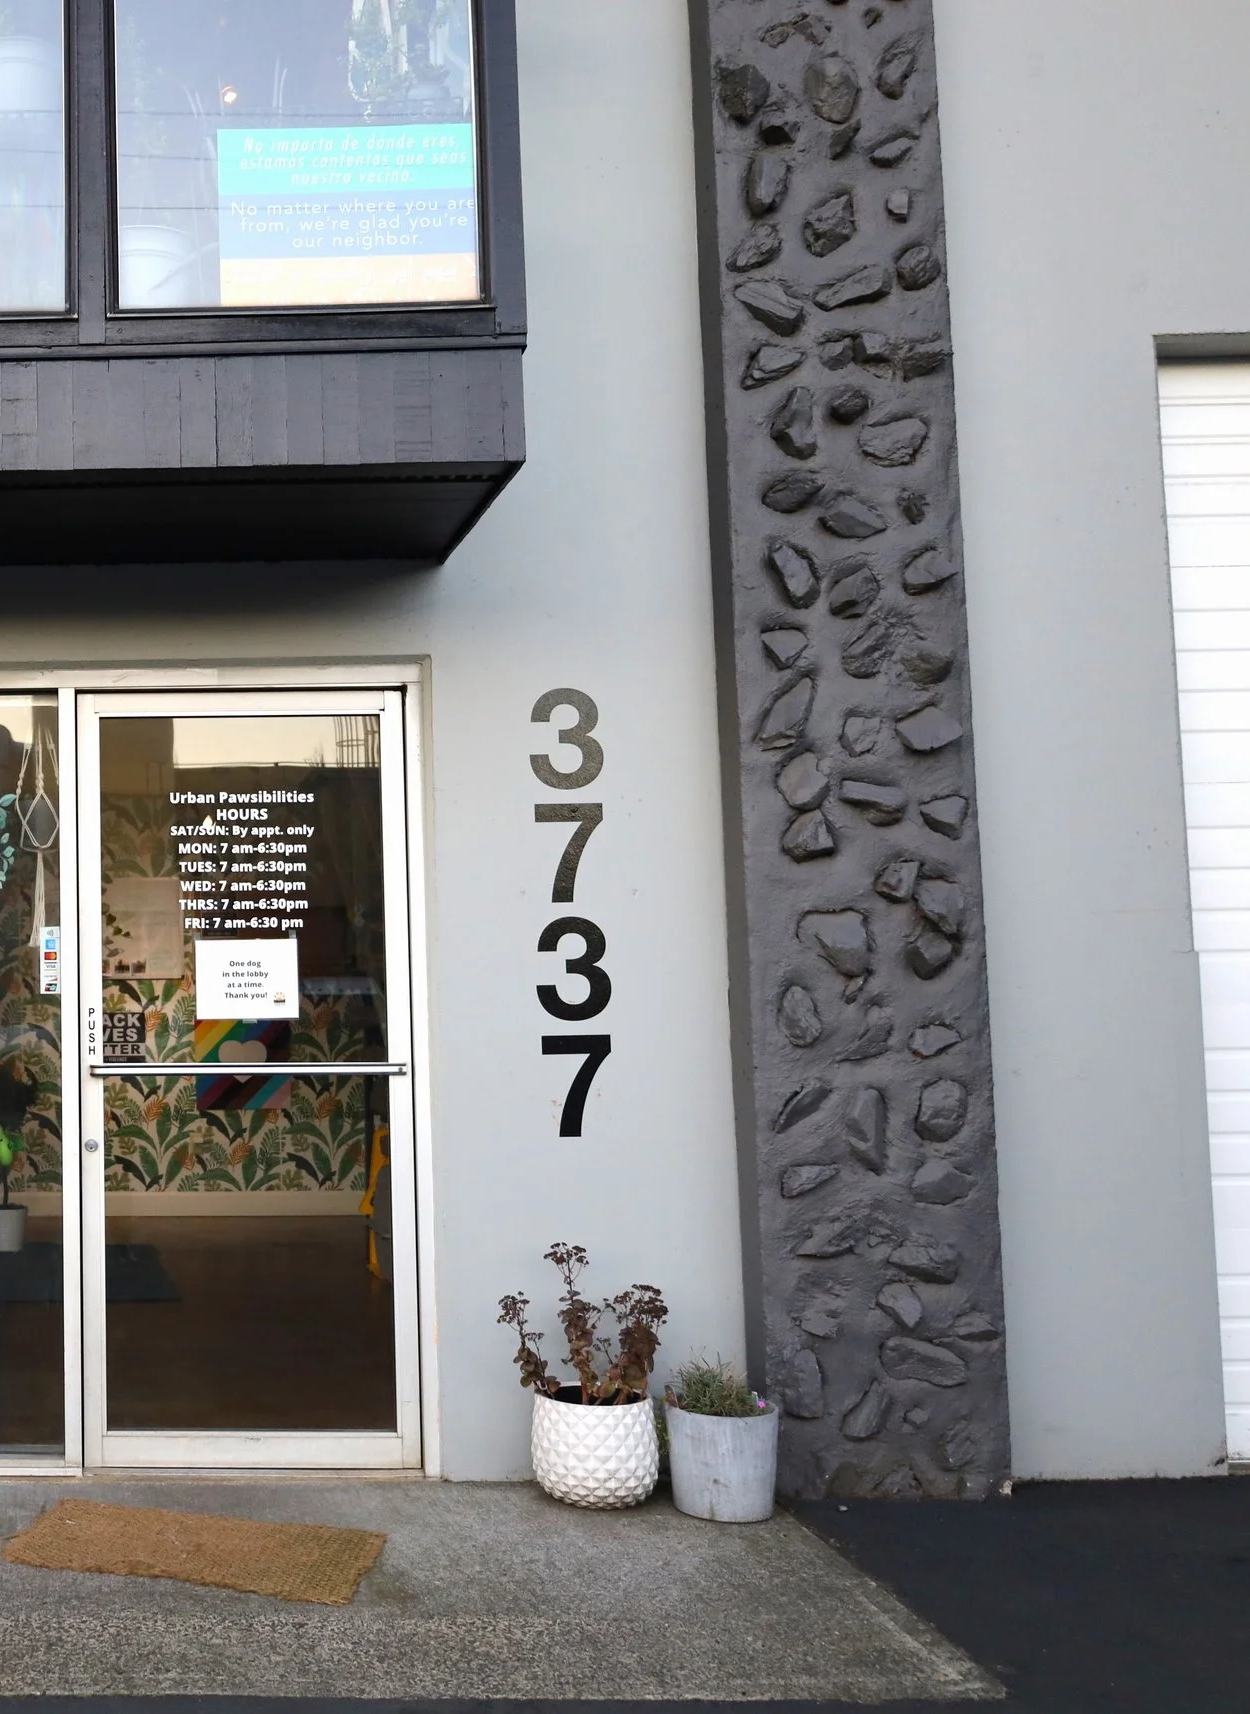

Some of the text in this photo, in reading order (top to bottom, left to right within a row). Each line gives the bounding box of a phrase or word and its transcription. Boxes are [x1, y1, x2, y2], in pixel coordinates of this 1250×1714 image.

[243, 136, 263, 153] No
[271, 137, 333, 156] importa
[342, 133, 359, 150] de
[239, 155, 306, 170] estamos
[396, 152, 424, 169] que
[431, 151, 466, 165] seas
[290, 171, 351, 187] nuestro
[231, 199, 476, 216] No matter where you are
[240, 212, 468, 233] from, we're glad you're
[292, 231, 423, 250] our neighbor.
[169, 790, 315, 804] Urban Pawsibilities
[216, 808, 268, 821] HOURS
[170, 824, 315, 838] SAT/SUN: By appt. only
[178, 842, 307, 856] MON: 7 am-6:30pm
[179, 861, 307, 875] TUES: 7 am-6:30pm
[180, 880, 306, 893] WED: 7 am-6:30pm
[179, 898, 309, 912] THRS: 7 am-6:30pm
[529, 687, 612, 1138] 3737
[184, 917, 303, 931] FRI: 7 am-6:30 pm
[247, 960, 262, 968] dog
[247, 970, 269, 978] lobby
[251, 992, 268, 1000] you!
[103, 1013, 141, 1027] ACK
[103, 1028, 138, 1042] VES
